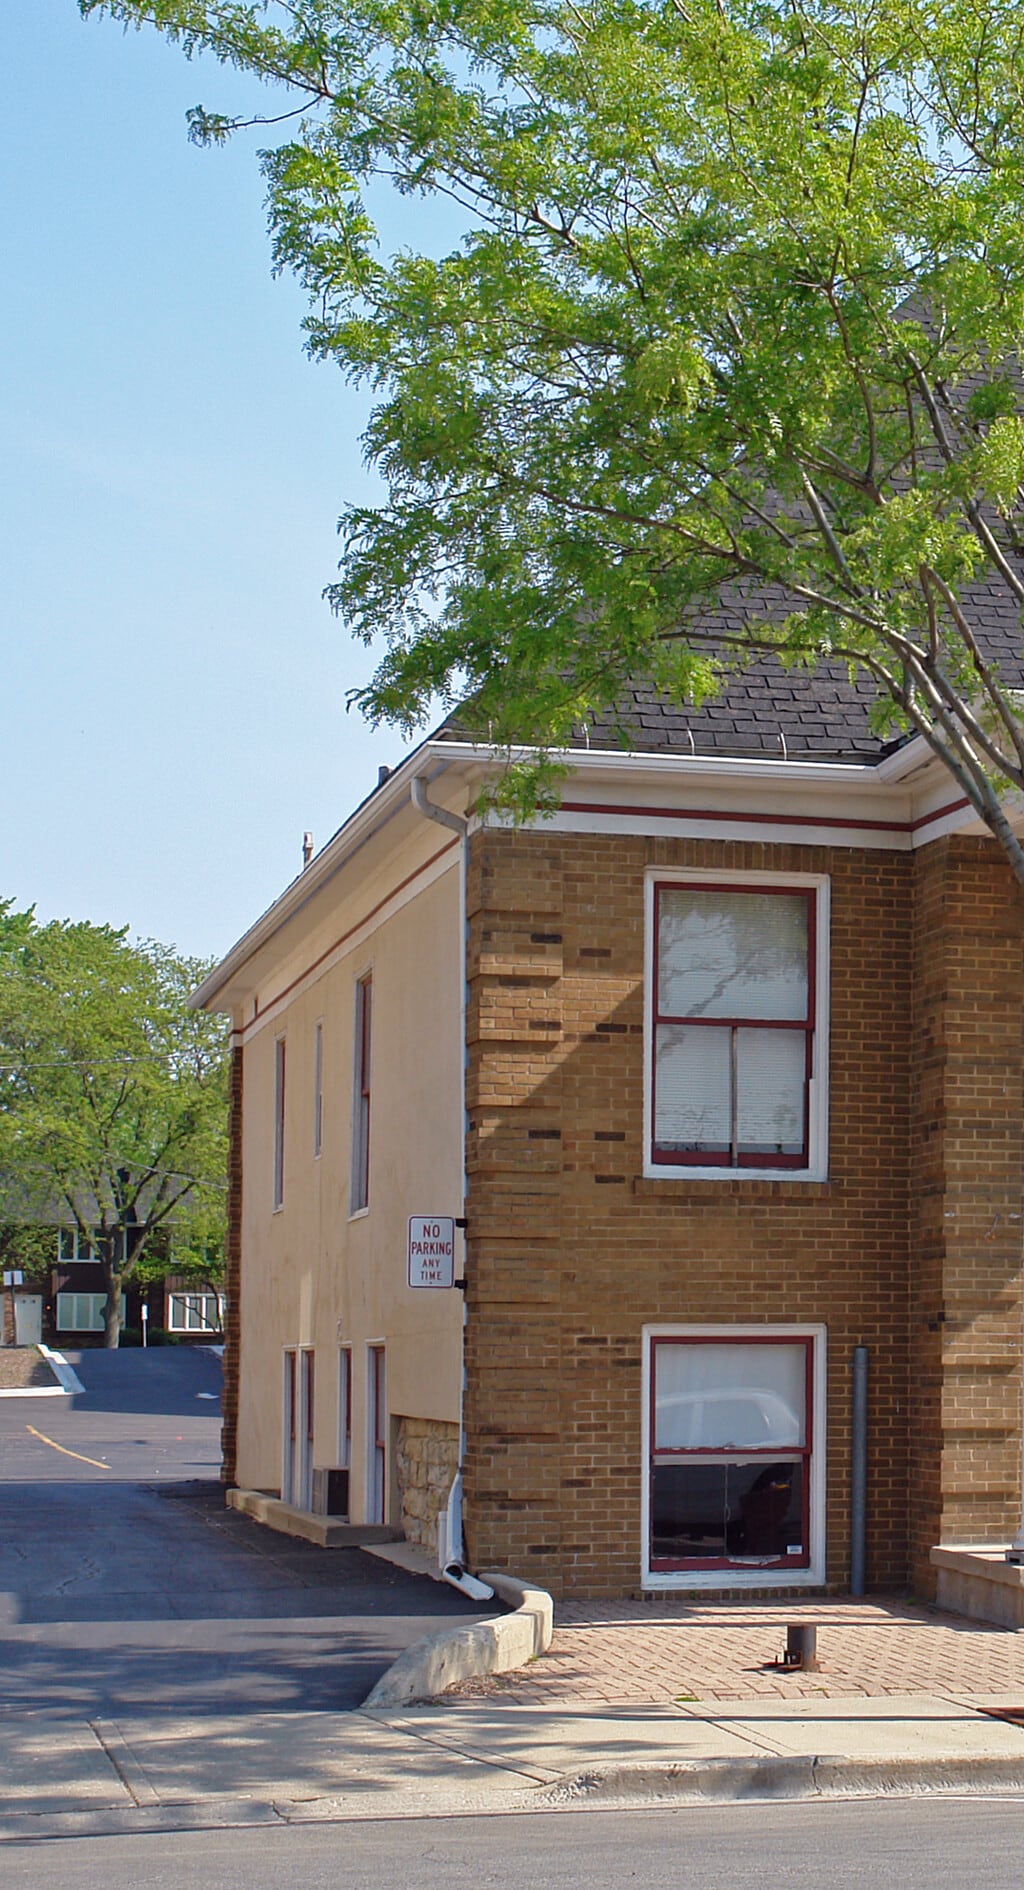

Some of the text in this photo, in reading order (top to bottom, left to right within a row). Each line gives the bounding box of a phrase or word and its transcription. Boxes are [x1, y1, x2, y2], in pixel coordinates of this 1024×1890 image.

[423, 1224, 440, 1238] NO
[411, 1241, 451, 1255] PARKING
[422, 1258, 440, 1268] ANY
[420, 1271, 442, 1280] TIME
